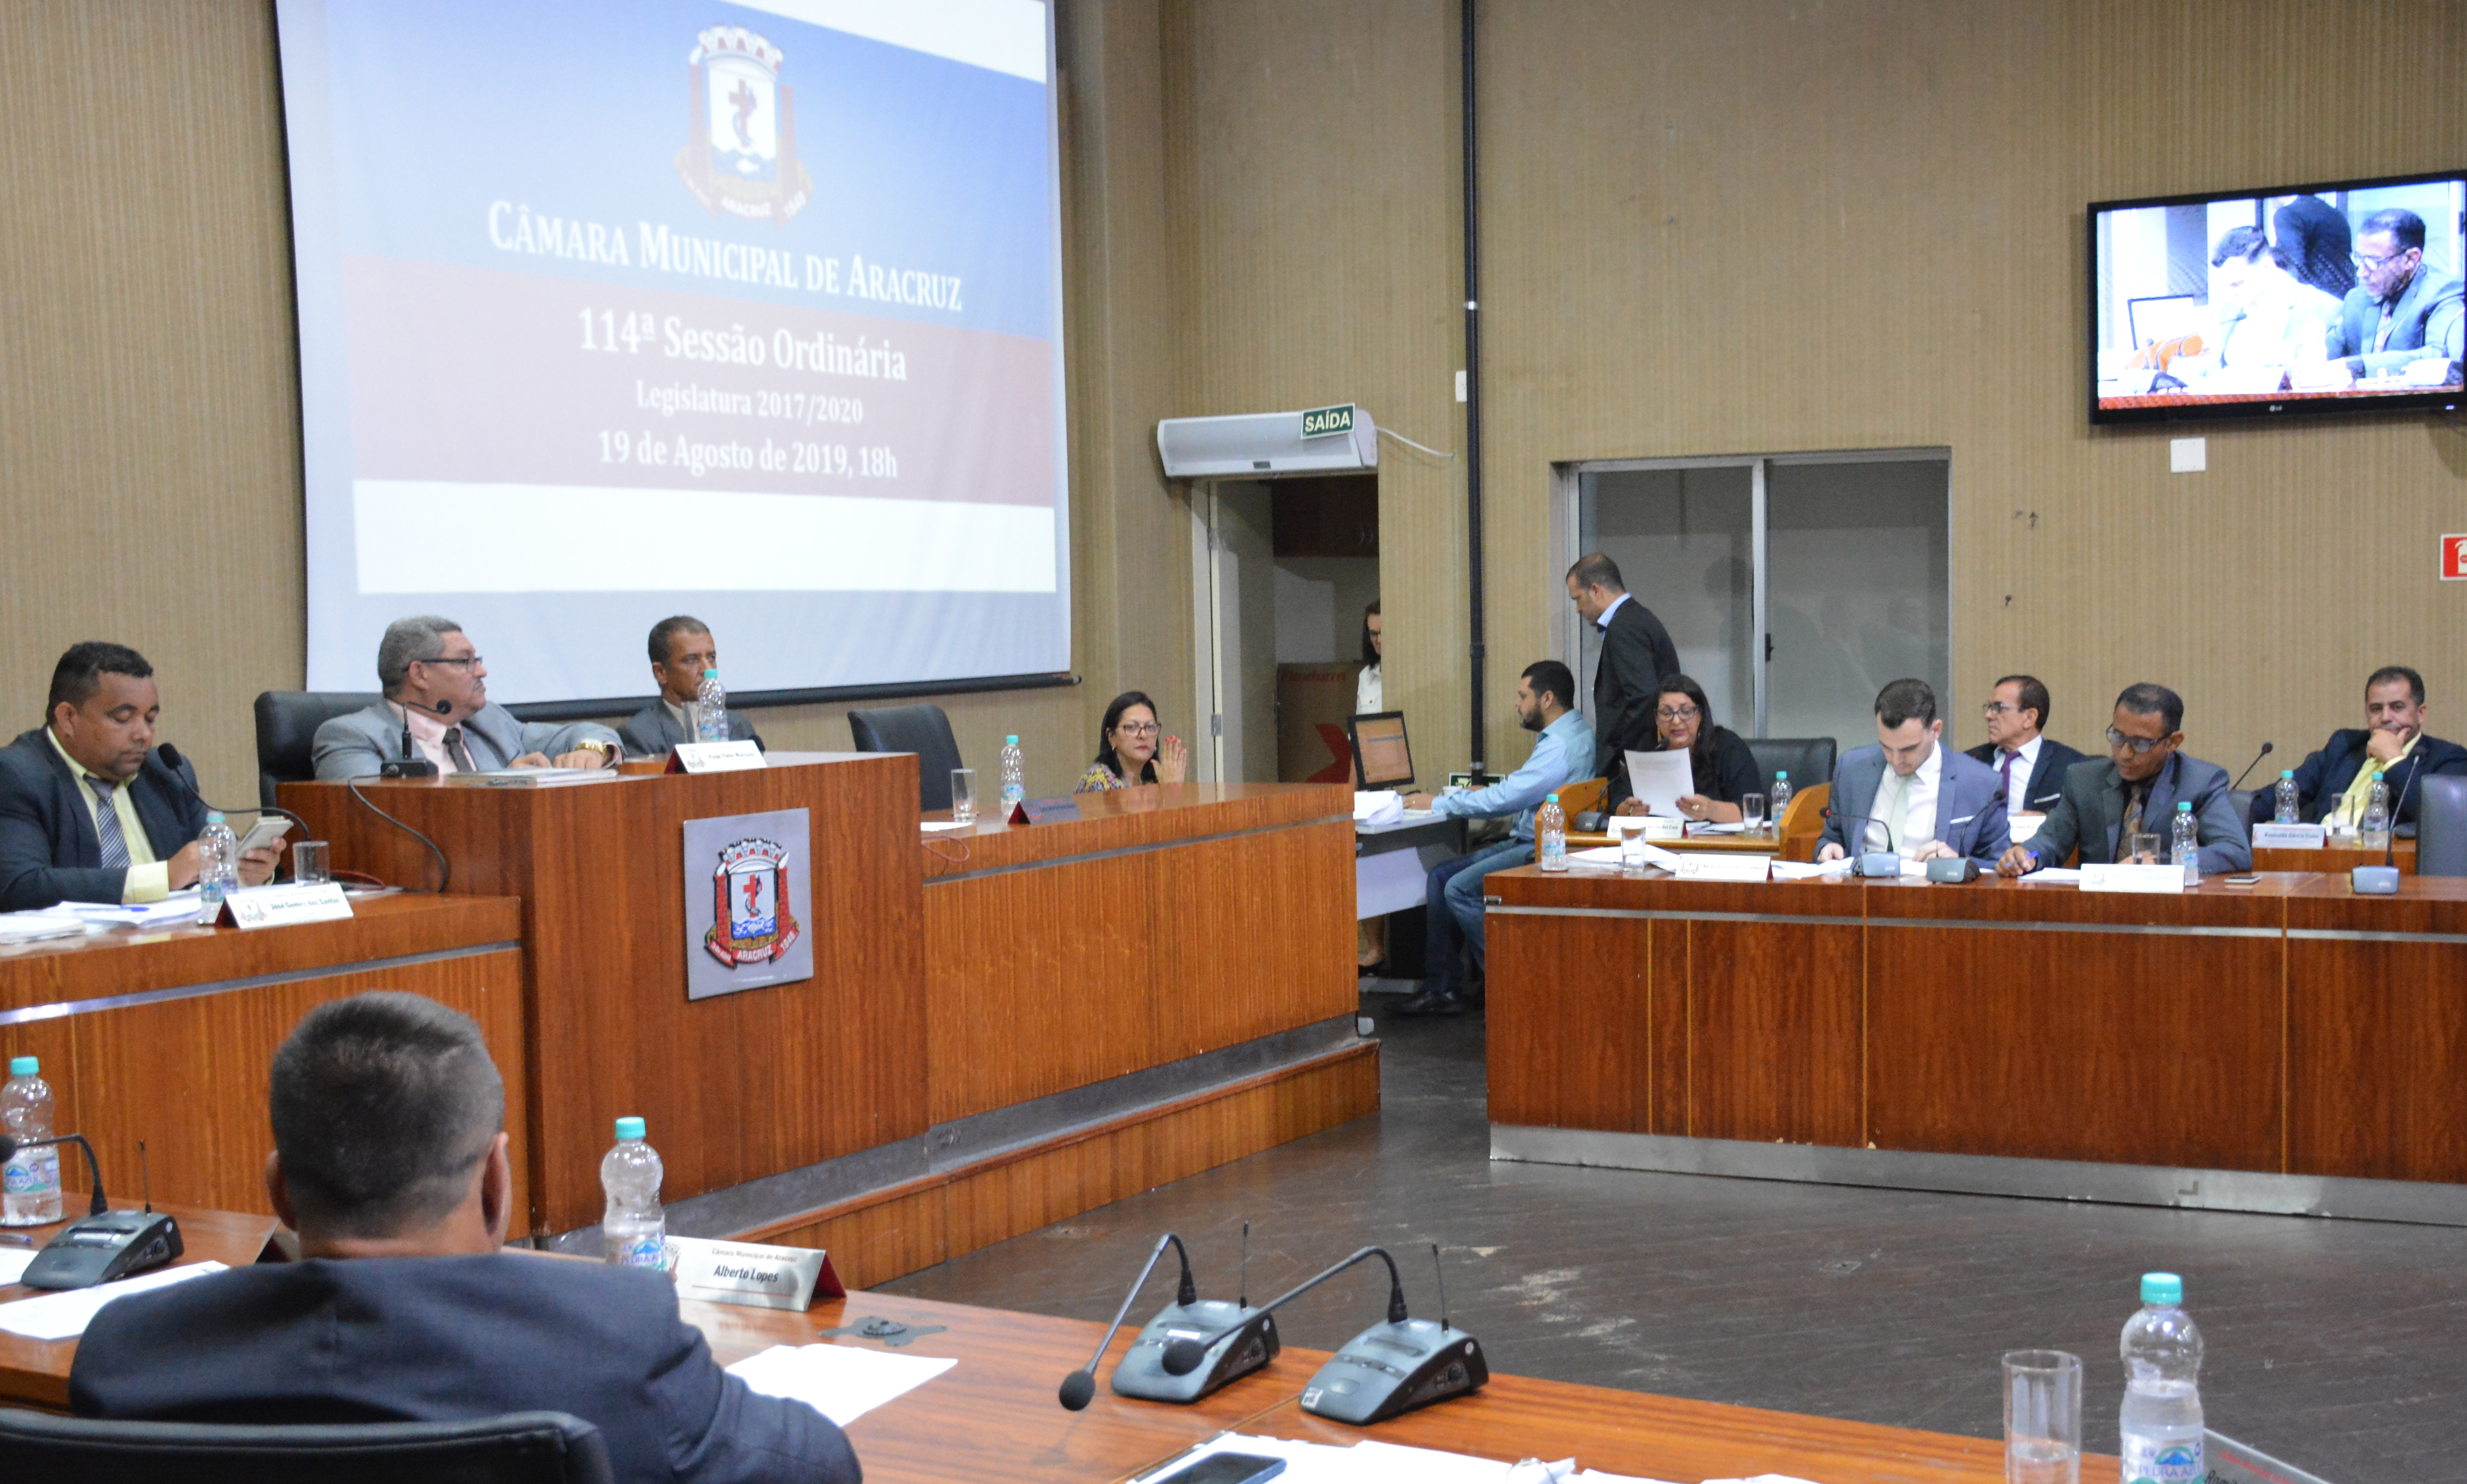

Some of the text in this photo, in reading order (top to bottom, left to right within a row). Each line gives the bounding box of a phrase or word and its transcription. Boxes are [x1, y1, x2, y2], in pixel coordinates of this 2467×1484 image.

[721, 196, 771, 217] ARACRUZ
[488, 199, 629, 265] CÂMARA
[639, 221, 798, 290] MUNICIPAL
[848, 253, 963, 311] ARACRUZ
[663, 316, 766, 366] Sessão
[773, 329, 907, 382] Ordinária
[636, 380, 864, 426] Legislatura 2017/2020
[1305, 410, 1351, 433] SAÍDA
[599, 430, 899, 478] 19 de Agosto de 2019, 18h
[737, 944, 773, 961] ARACRUZ
[712, 1247, 735, 1257] Câmara
[736, 1250, 765, 1260] Municipal
[774, 1255, 798, 1263] Aracruz
[713, 1264, 779, 1284] Alberto Lopes
